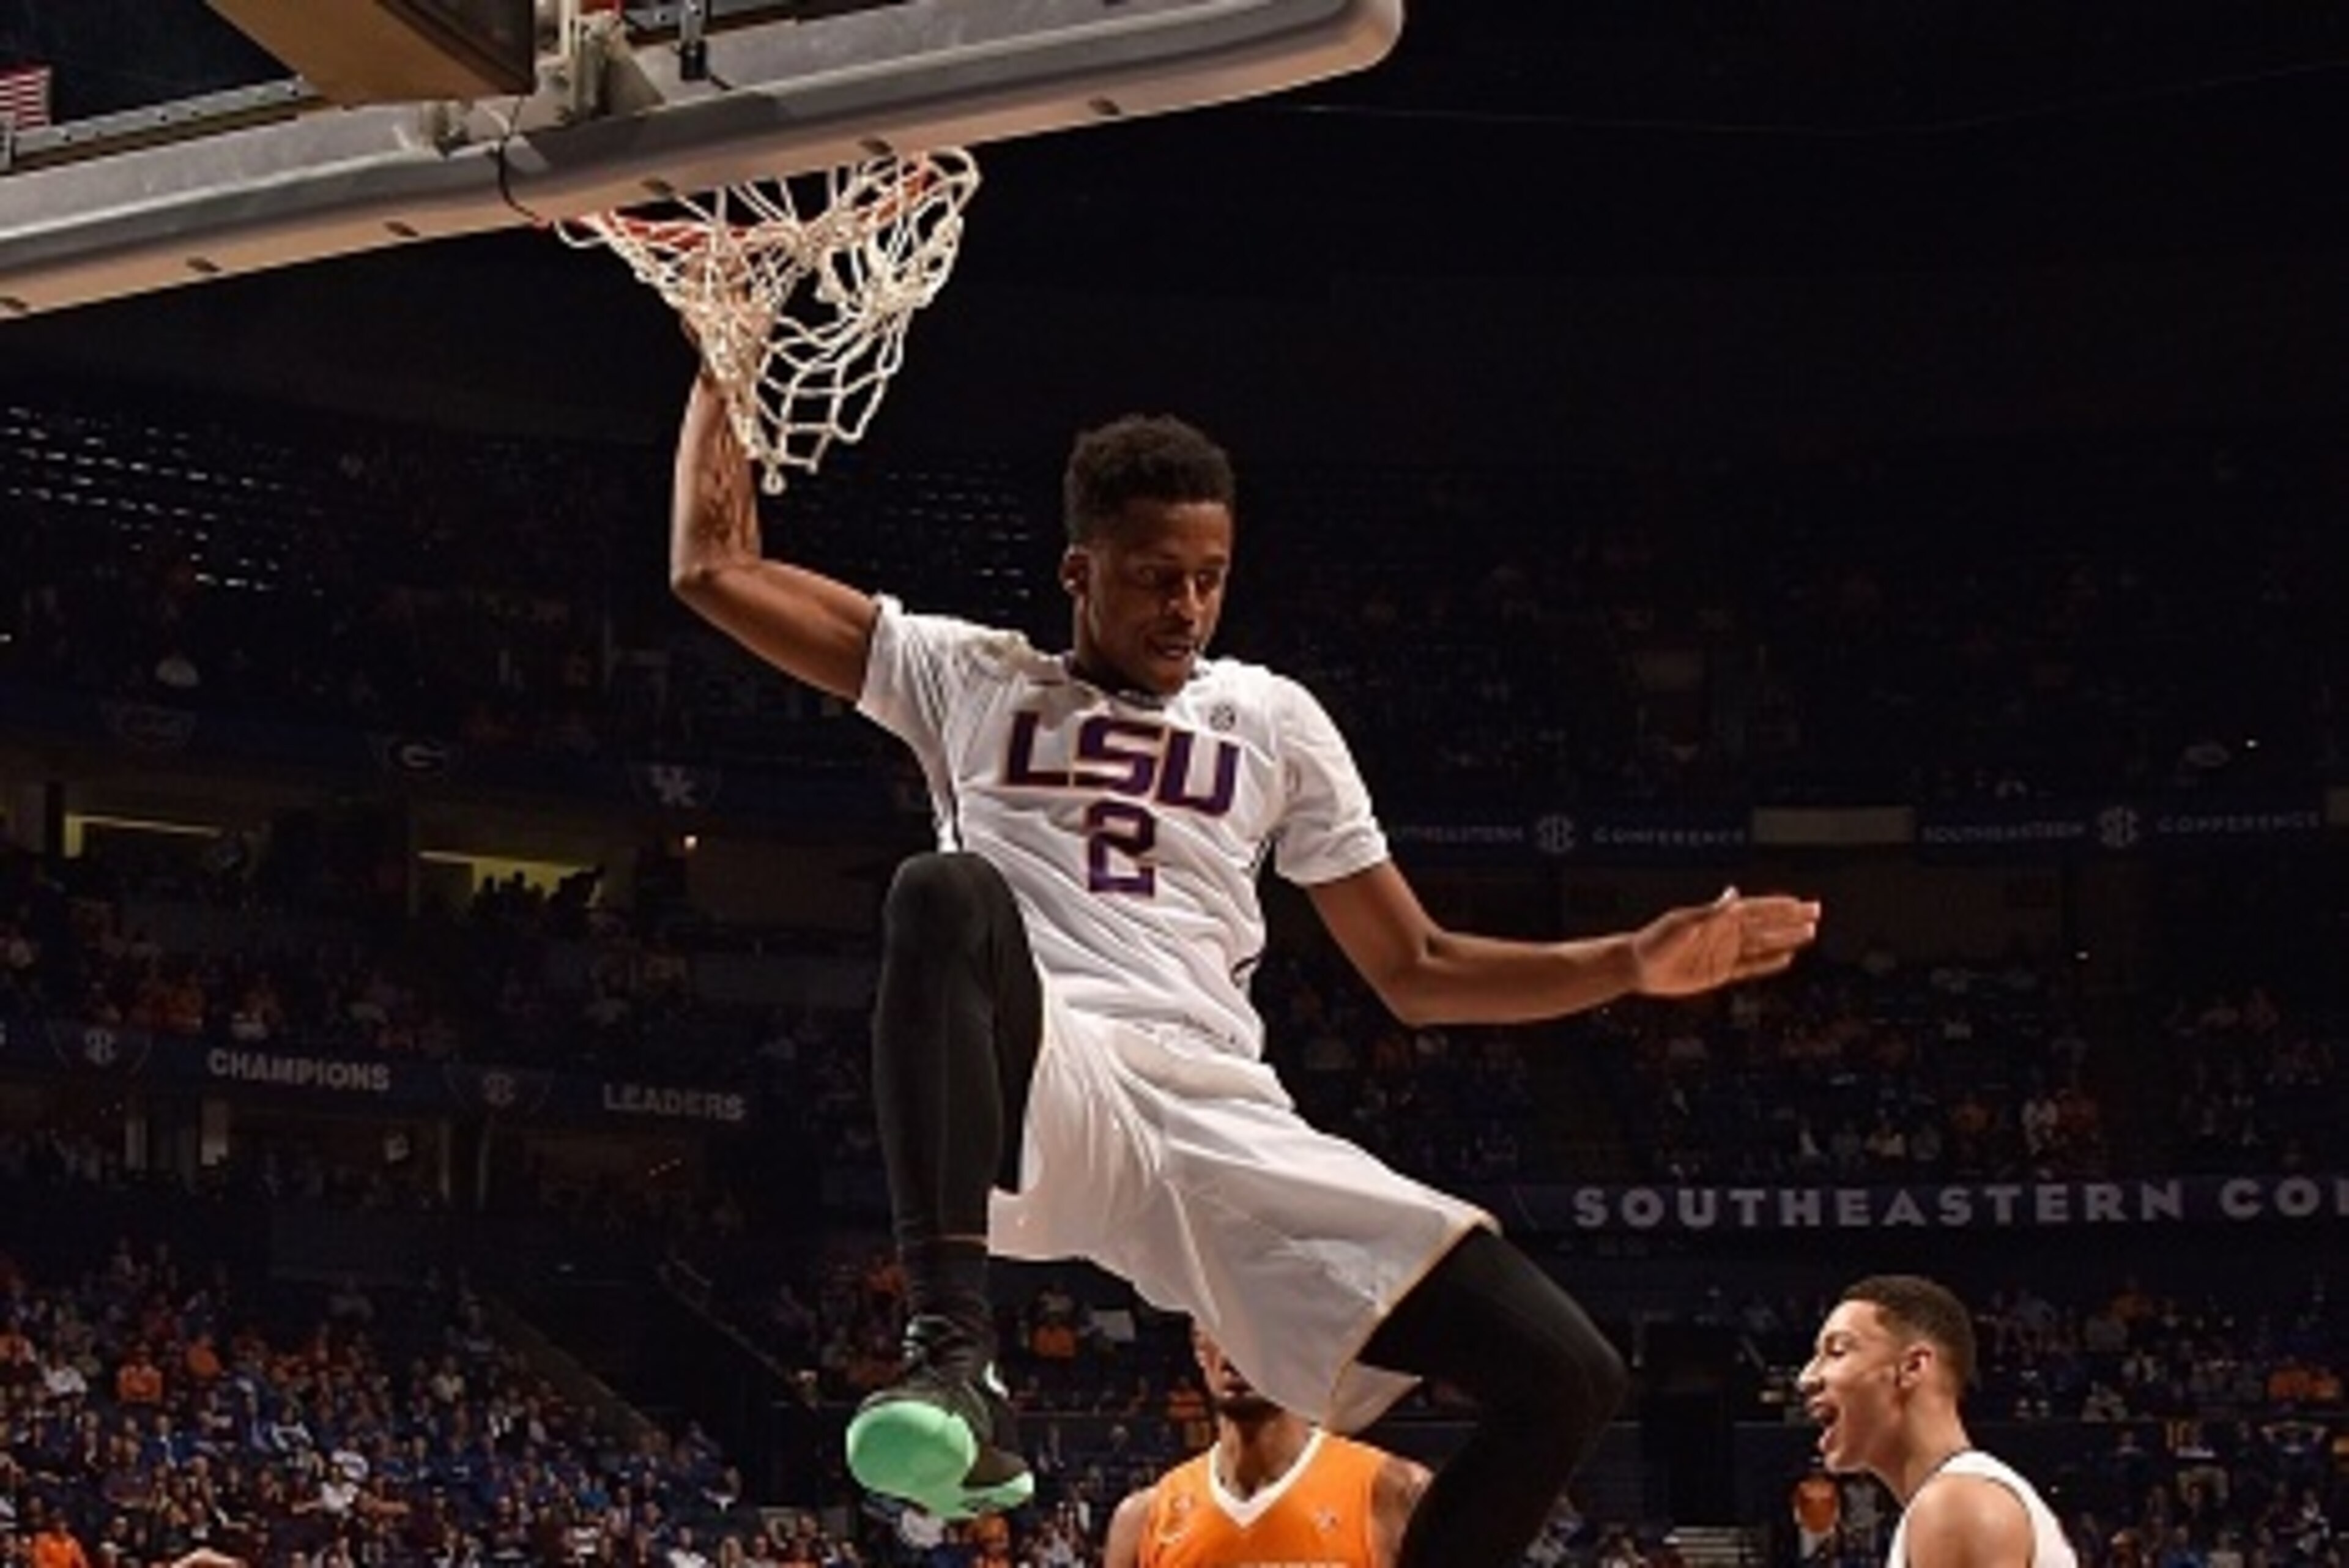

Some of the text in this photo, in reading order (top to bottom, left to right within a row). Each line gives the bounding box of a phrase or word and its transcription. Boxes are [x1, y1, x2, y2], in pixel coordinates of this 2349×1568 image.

[1002, 710, 1241, 817] LSU
[1084, 799, 1157, 897] 2
[206, 1047, 391, 1091] CHAMPIONS
[603, 1081, 748, 1121] LEADERS
[1571, 1177, 2184, 1230] SOUTHEASTERN
